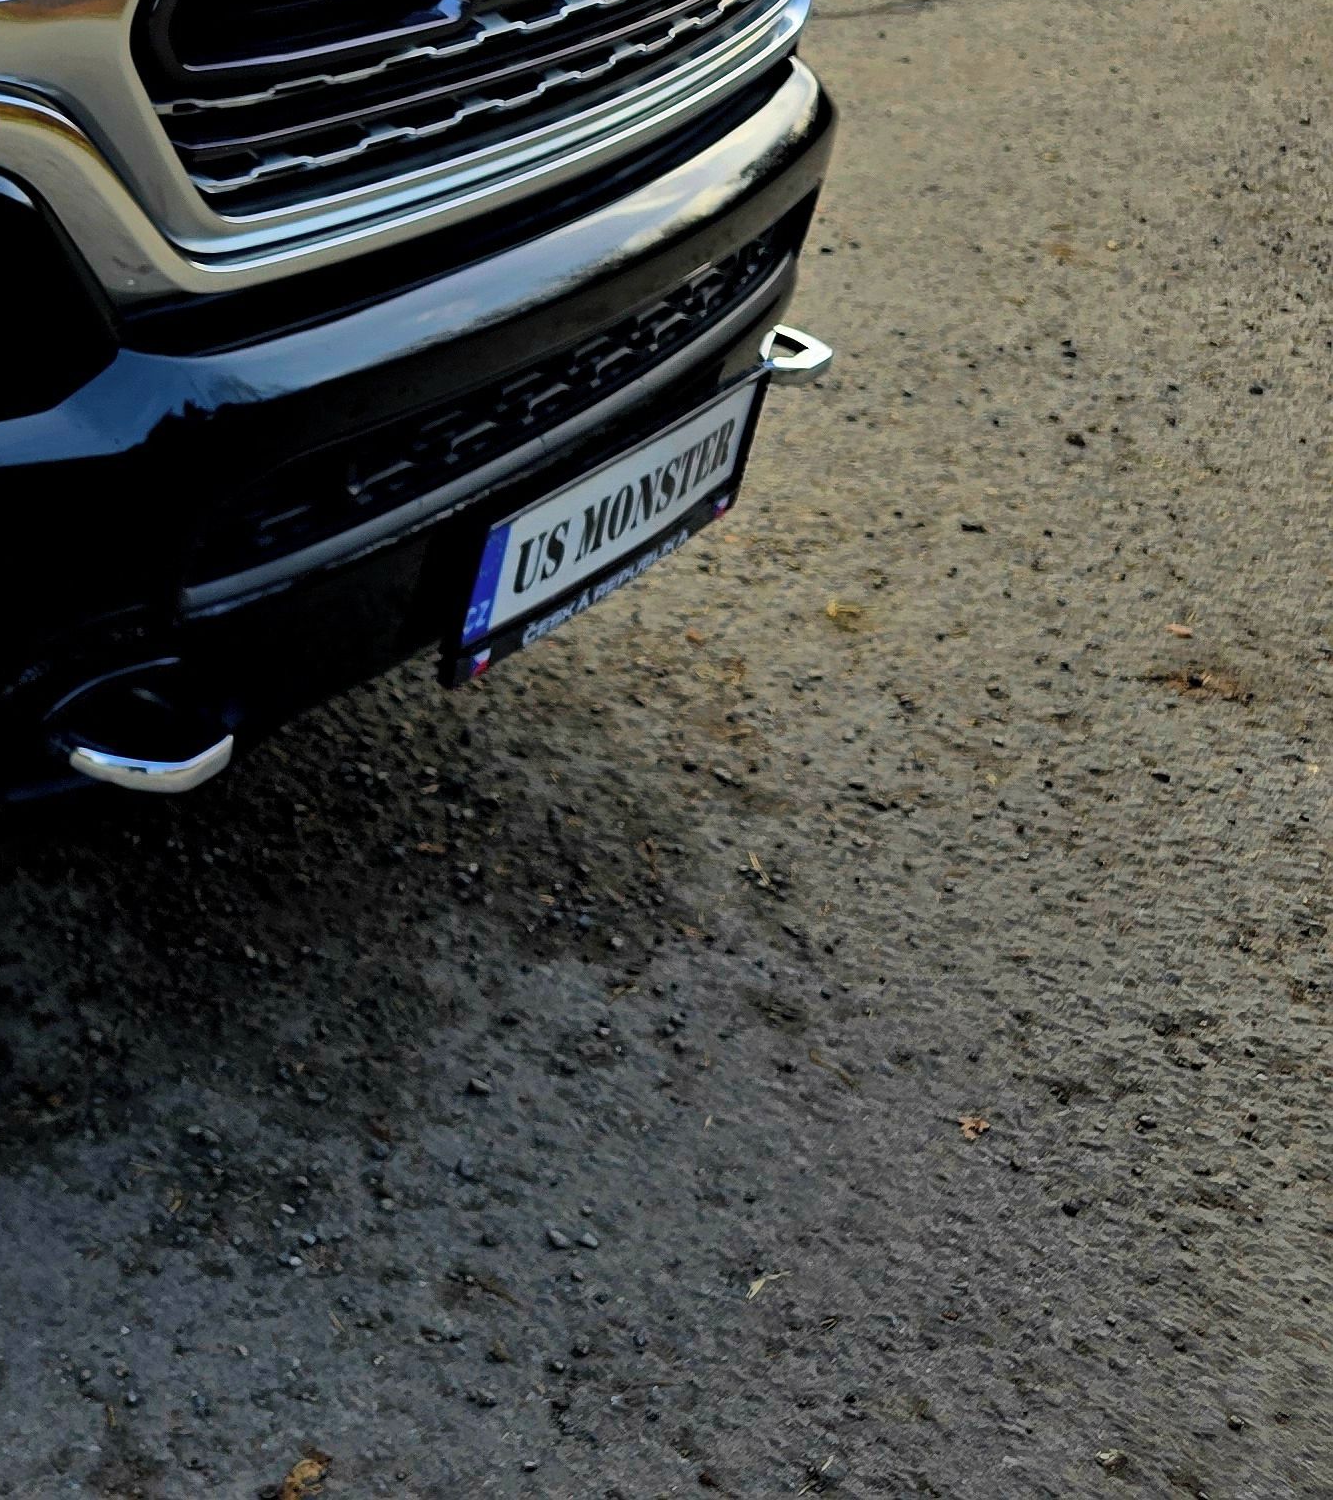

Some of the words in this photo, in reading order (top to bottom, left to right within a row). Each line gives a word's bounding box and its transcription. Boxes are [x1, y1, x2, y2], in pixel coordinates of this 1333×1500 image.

[513, 519, 571, 594] US
[574, 419, 735, 563] MONSTER
[463, 600, 490, 636] CZ
